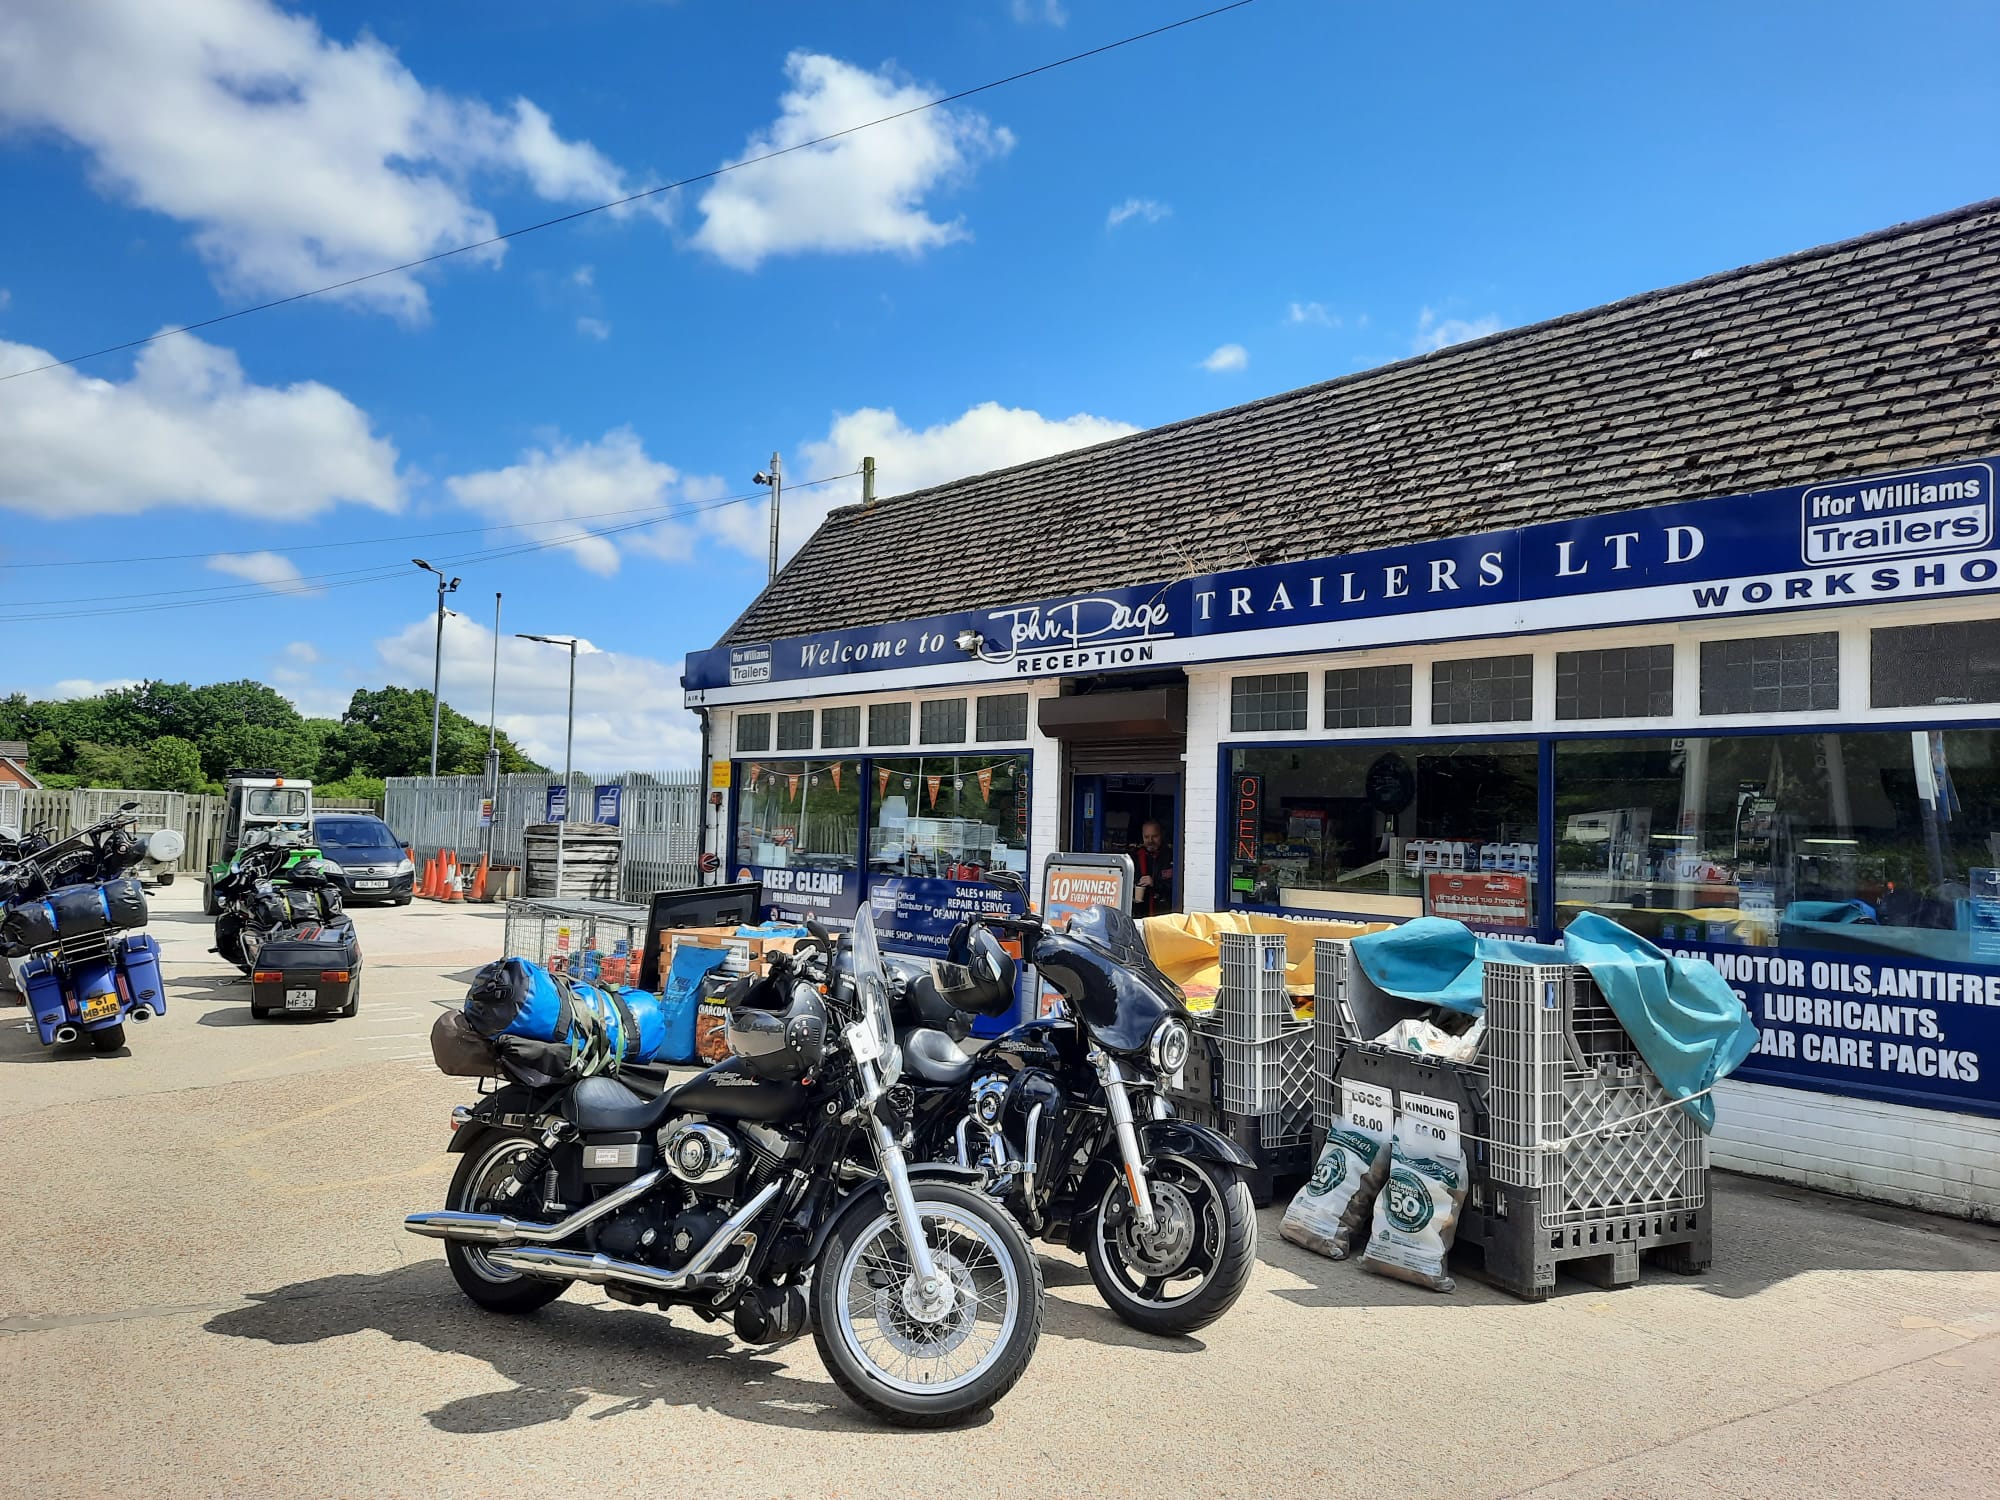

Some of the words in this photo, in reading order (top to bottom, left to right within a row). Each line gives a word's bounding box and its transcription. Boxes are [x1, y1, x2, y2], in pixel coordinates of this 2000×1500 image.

[1812, 495, 1856, 519] Ifor
[1860, 478, 1980, 512] Williams
[1813, 516, 1980, 552] Trailers
[1195, 551, 1504, 620] TRAILERS
[1555, 525, 1705, 577] LTD
[1693, 558, 1998, 608] WORKSHO
[978, 606, 1062, 663] John
[1047, 598, 1169, 648] Page
[744, 650, 769, 662] Williams
[801, 638, 908, 669] Welcome
[919, 632, 945, 654] to
[1017, 646, 1153, 673] RECEPTION
[733, 666, 768, 680] Trailers
[1238, 778, 1257, 860] OPEN
[763, 869, 794, 890] KEEP
[796, 871, 844, 895] CLEAR!
[956, 887, 978, 899] SALES
[985, 890, 1002, 901] HIRE
[1051, 878, 1070, 902] 10
[1070, 879, 1117, 895] WINNERS
[947, 898, 973, 910] REPAIR
[974, 901, 980, 910] &
[981, 901, 1011, 914] SERVICE
[1070, 893, 1090, 903] EVERY
[1091, 894, 1115, 906] MONTH
[942, 909, 960, 920] ANY
[874, 928, 895, 939] ONLINE
[896, 931, 914, 942] SHOP:
[1713, 953, 1805, 989] MOTOR
[295, 991, 307, 999] 24
[83, 1003, 118, 1019] MB-HR
[1763, 992, 1945, 1043] LUBRICANTS,
[1751, 1028, 1795, 1058] AR
[1802, 1034, 1874, 1070] CARE
[1880, 1042, 1980, 1083] PACKS
[1352, 1113, 1383, 1132] £8.00
[1404, 1101, 1455, 1121] KINDLING
[1390, 1190, 1421, 1218] 50
